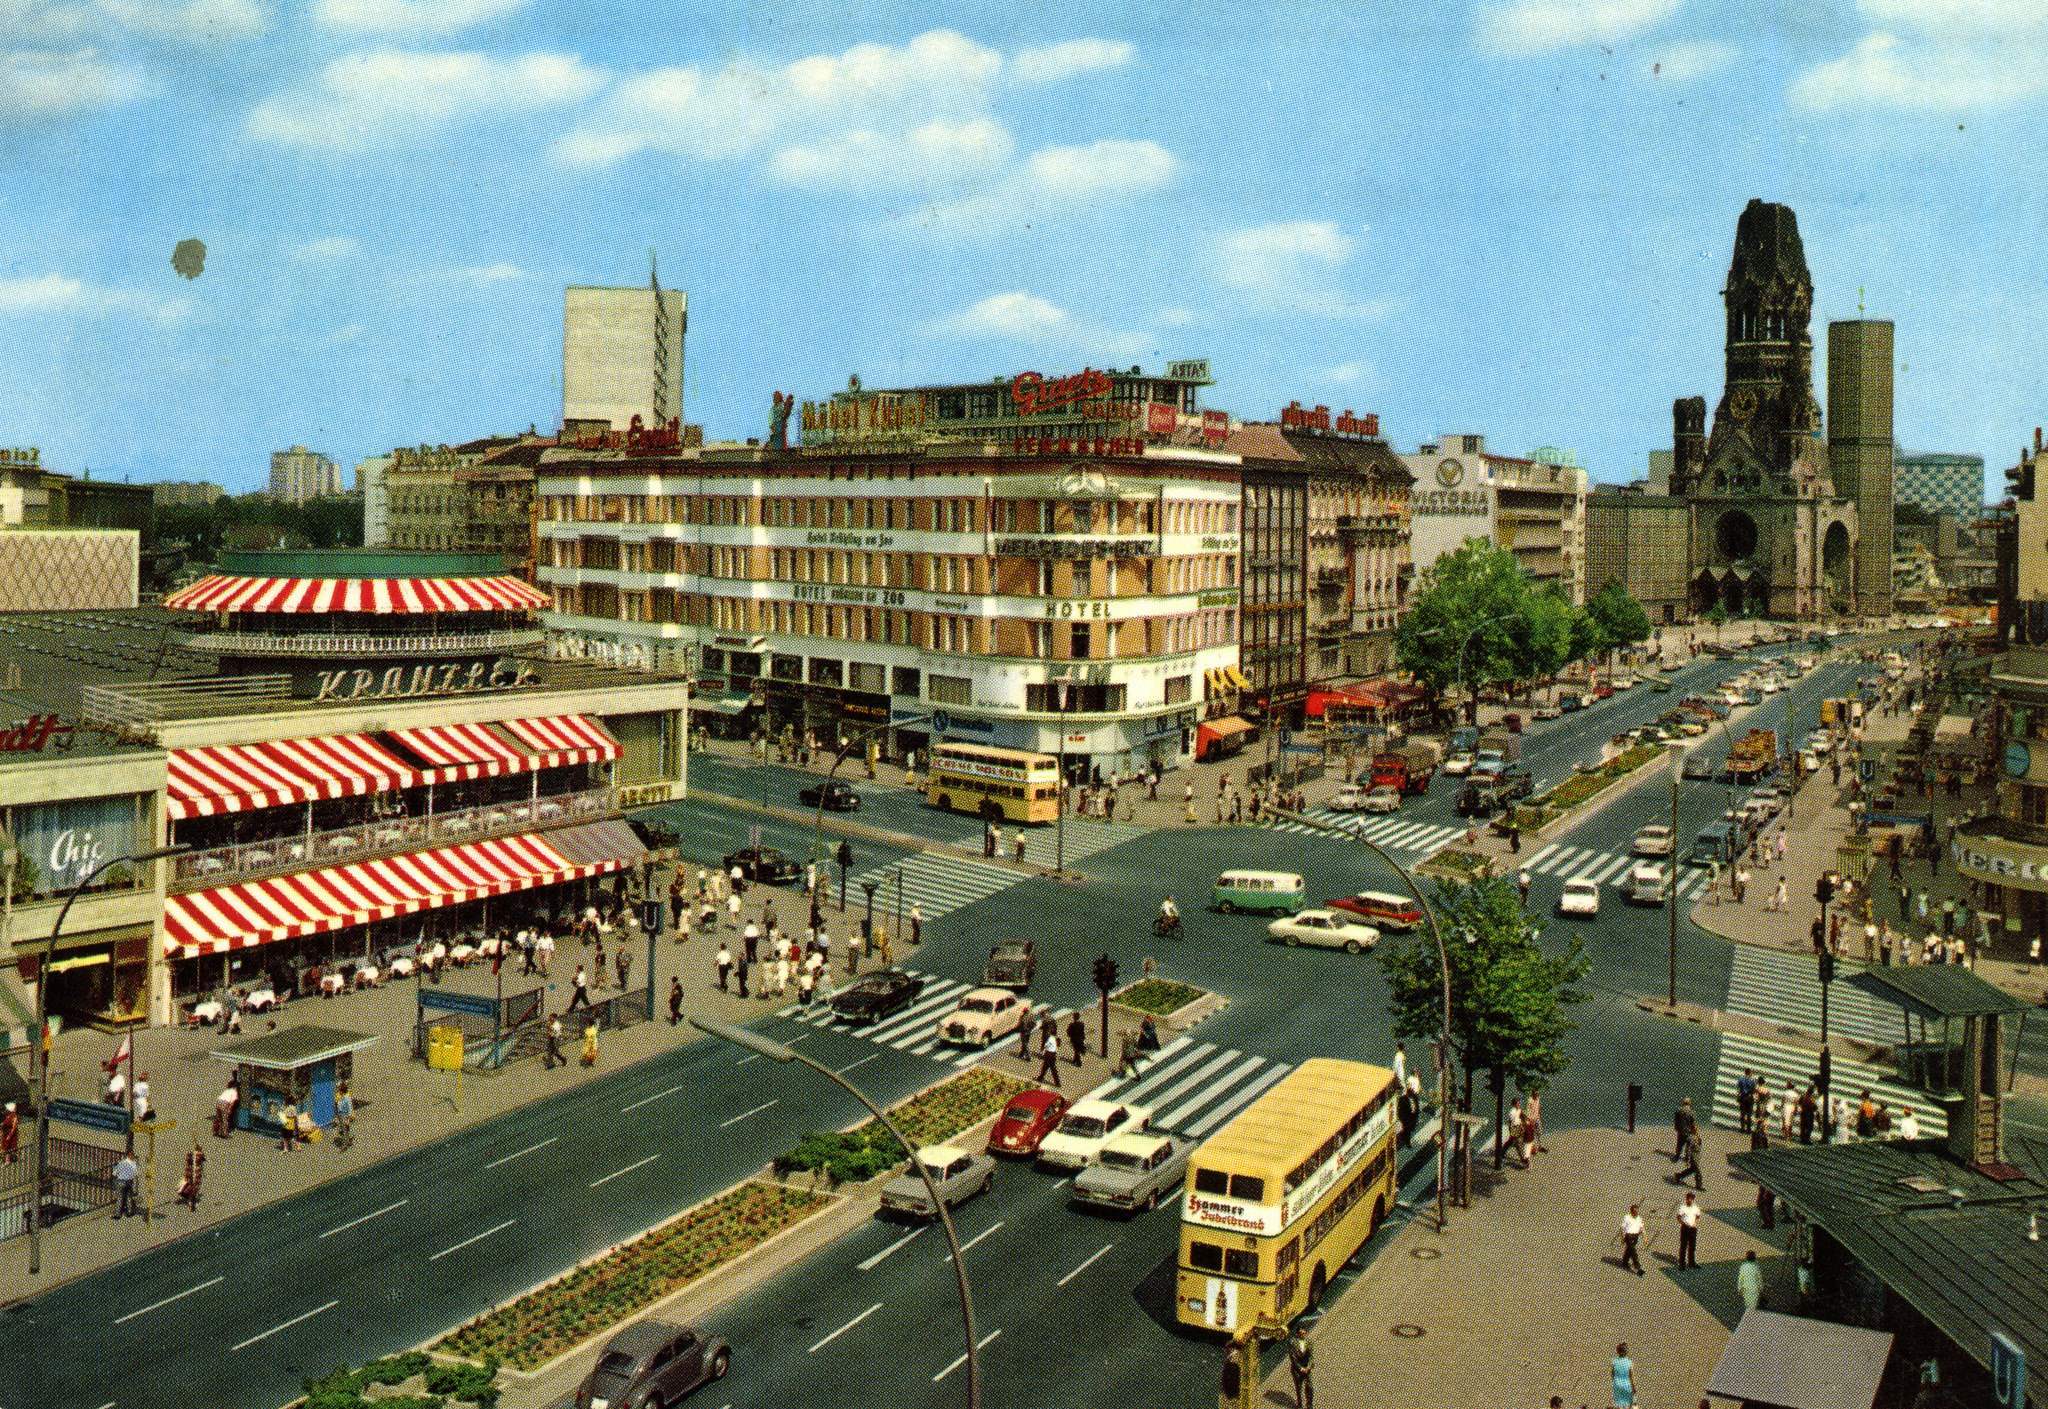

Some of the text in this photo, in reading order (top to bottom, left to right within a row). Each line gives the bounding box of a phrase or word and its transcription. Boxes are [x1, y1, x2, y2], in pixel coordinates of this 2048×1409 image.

[1083, 401, 1142, 420] RADIO
[1411, 490, 1489, 505] VICTORIA
[793, 585, 826, 600] HOTEL
[882, 591, 905, 606] ZOO
[1045, 602, 1112, 618] HOTEL
[315, 660, 542, 702] KRANZLER
[50, 828, 105, 872] Chic
[1187, 1194, 1245, 1216] Hammer
[1994, 1349, 2011, 1404] U
